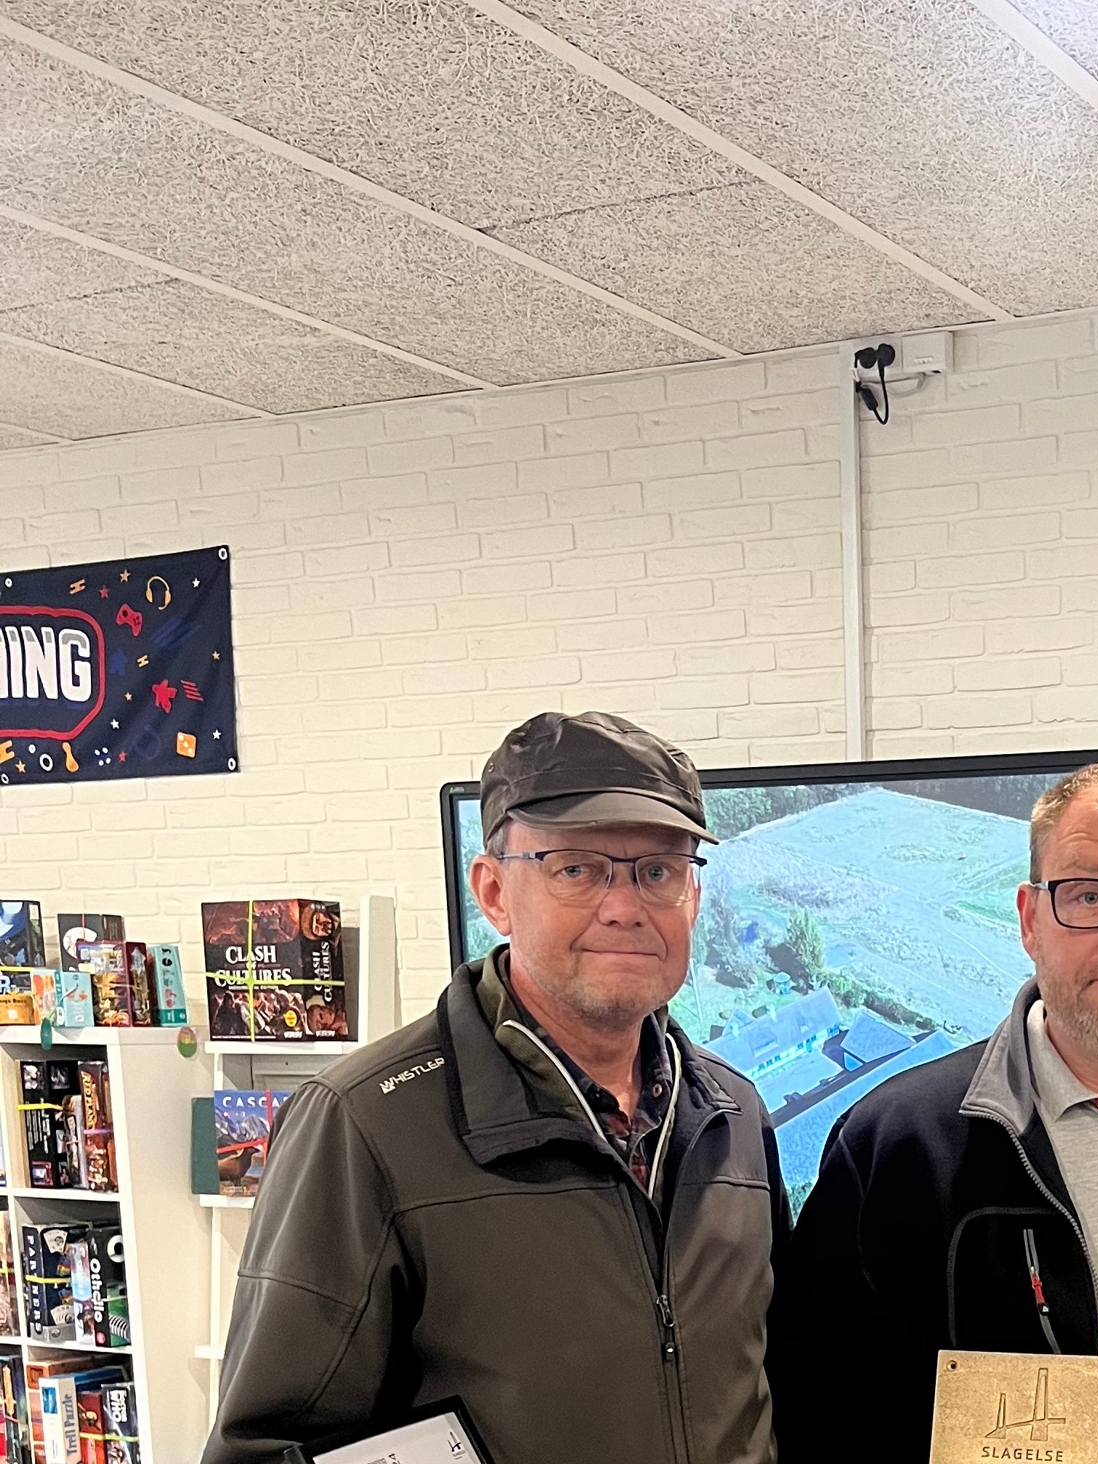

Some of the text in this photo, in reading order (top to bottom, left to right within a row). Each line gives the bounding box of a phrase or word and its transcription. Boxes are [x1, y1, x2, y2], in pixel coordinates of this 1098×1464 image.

[225, 945, 277, 964] CLASH
[312, 951, 322, 991] CASH
[321, 942, 332, 1002] CUTURES
[379, 1057, 445, 1092] WHISTLER
[85, 1096, 97, 1130] PLANE
[26, 1235, 43, 1333] PARNERS
[90, 1258, 105, 1323] Othello
[981, 1446, 1064, 1463] SLAGELSE
